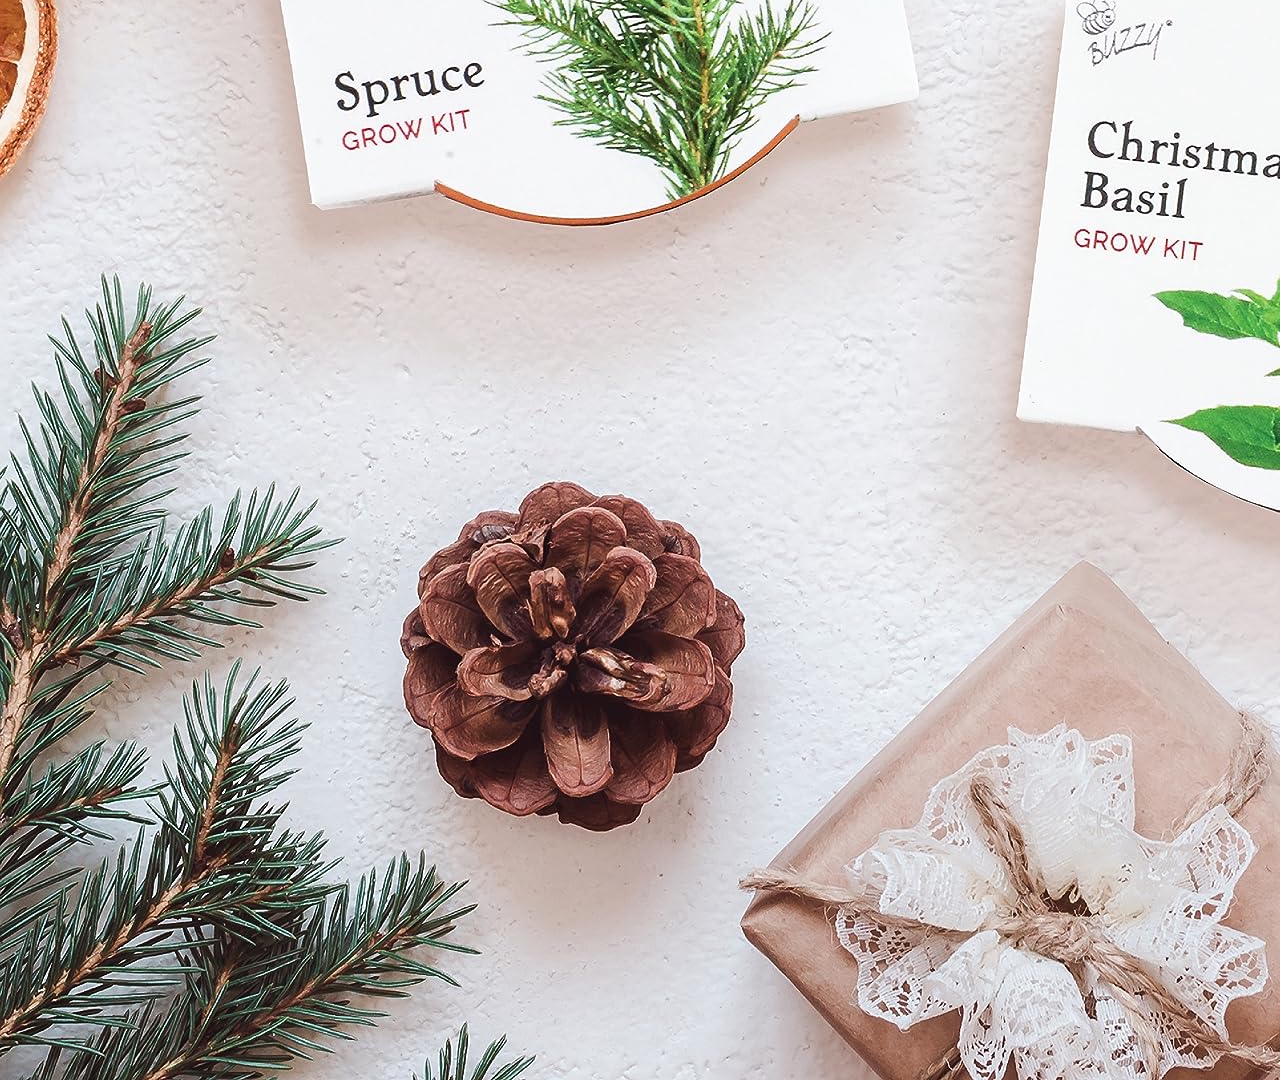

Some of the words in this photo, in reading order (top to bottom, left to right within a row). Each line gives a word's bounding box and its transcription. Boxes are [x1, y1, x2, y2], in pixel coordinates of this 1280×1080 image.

[334, 61, 486, 118] Spruce
[342, 117, 423, 151] GROW
[431, 109, 471, 135] KIT
[1080, 170, 1188, 219] Basil
[1073, 228, 1156, 256] GROW
[1163, 237, 1204, 261] KIT
